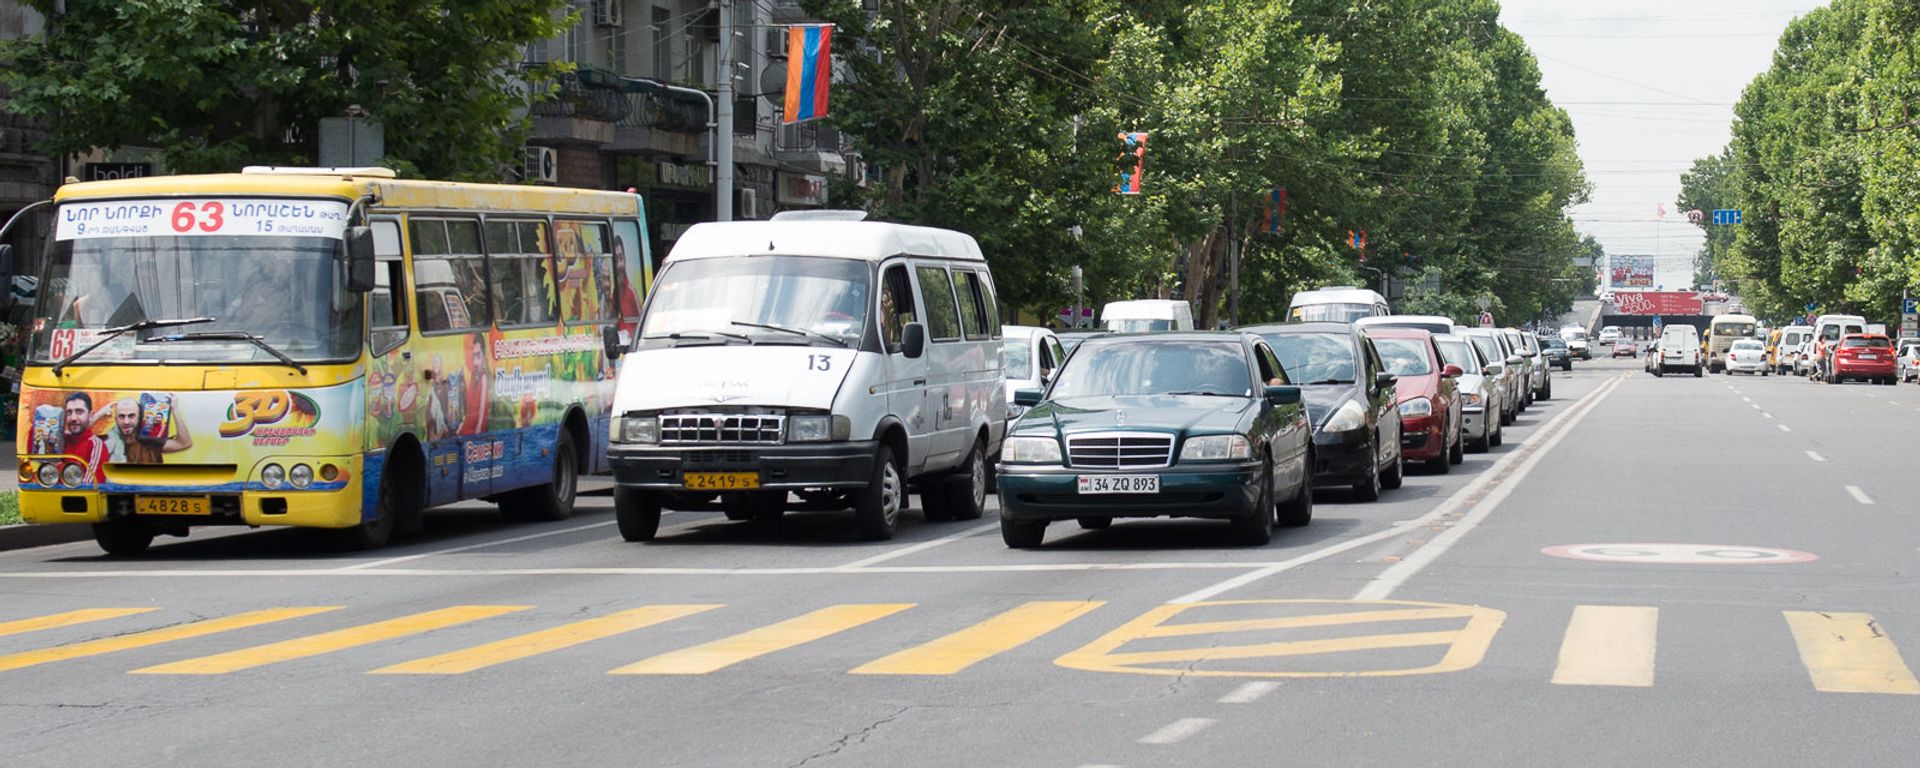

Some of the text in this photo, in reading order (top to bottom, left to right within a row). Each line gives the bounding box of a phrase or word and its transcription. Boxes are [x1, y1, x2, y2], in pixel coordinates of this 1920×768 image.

[66, 205, 162, 222] ՆՈՐ ՆՈՐՔԻ
[171, 201, 224, 233] 63
[232, 203, 315, 218] ՆՈՐԱՇԵՆ
[256, 220, 273, 232] 15
[52, 328, 76, 360] 63
[808, 354, 831, 372] 13
[697, 474, 736, 488] 2419
[1095, 477, 1156, 491] 34 ZQ 893
[148, 498, 189, 512] 4828
